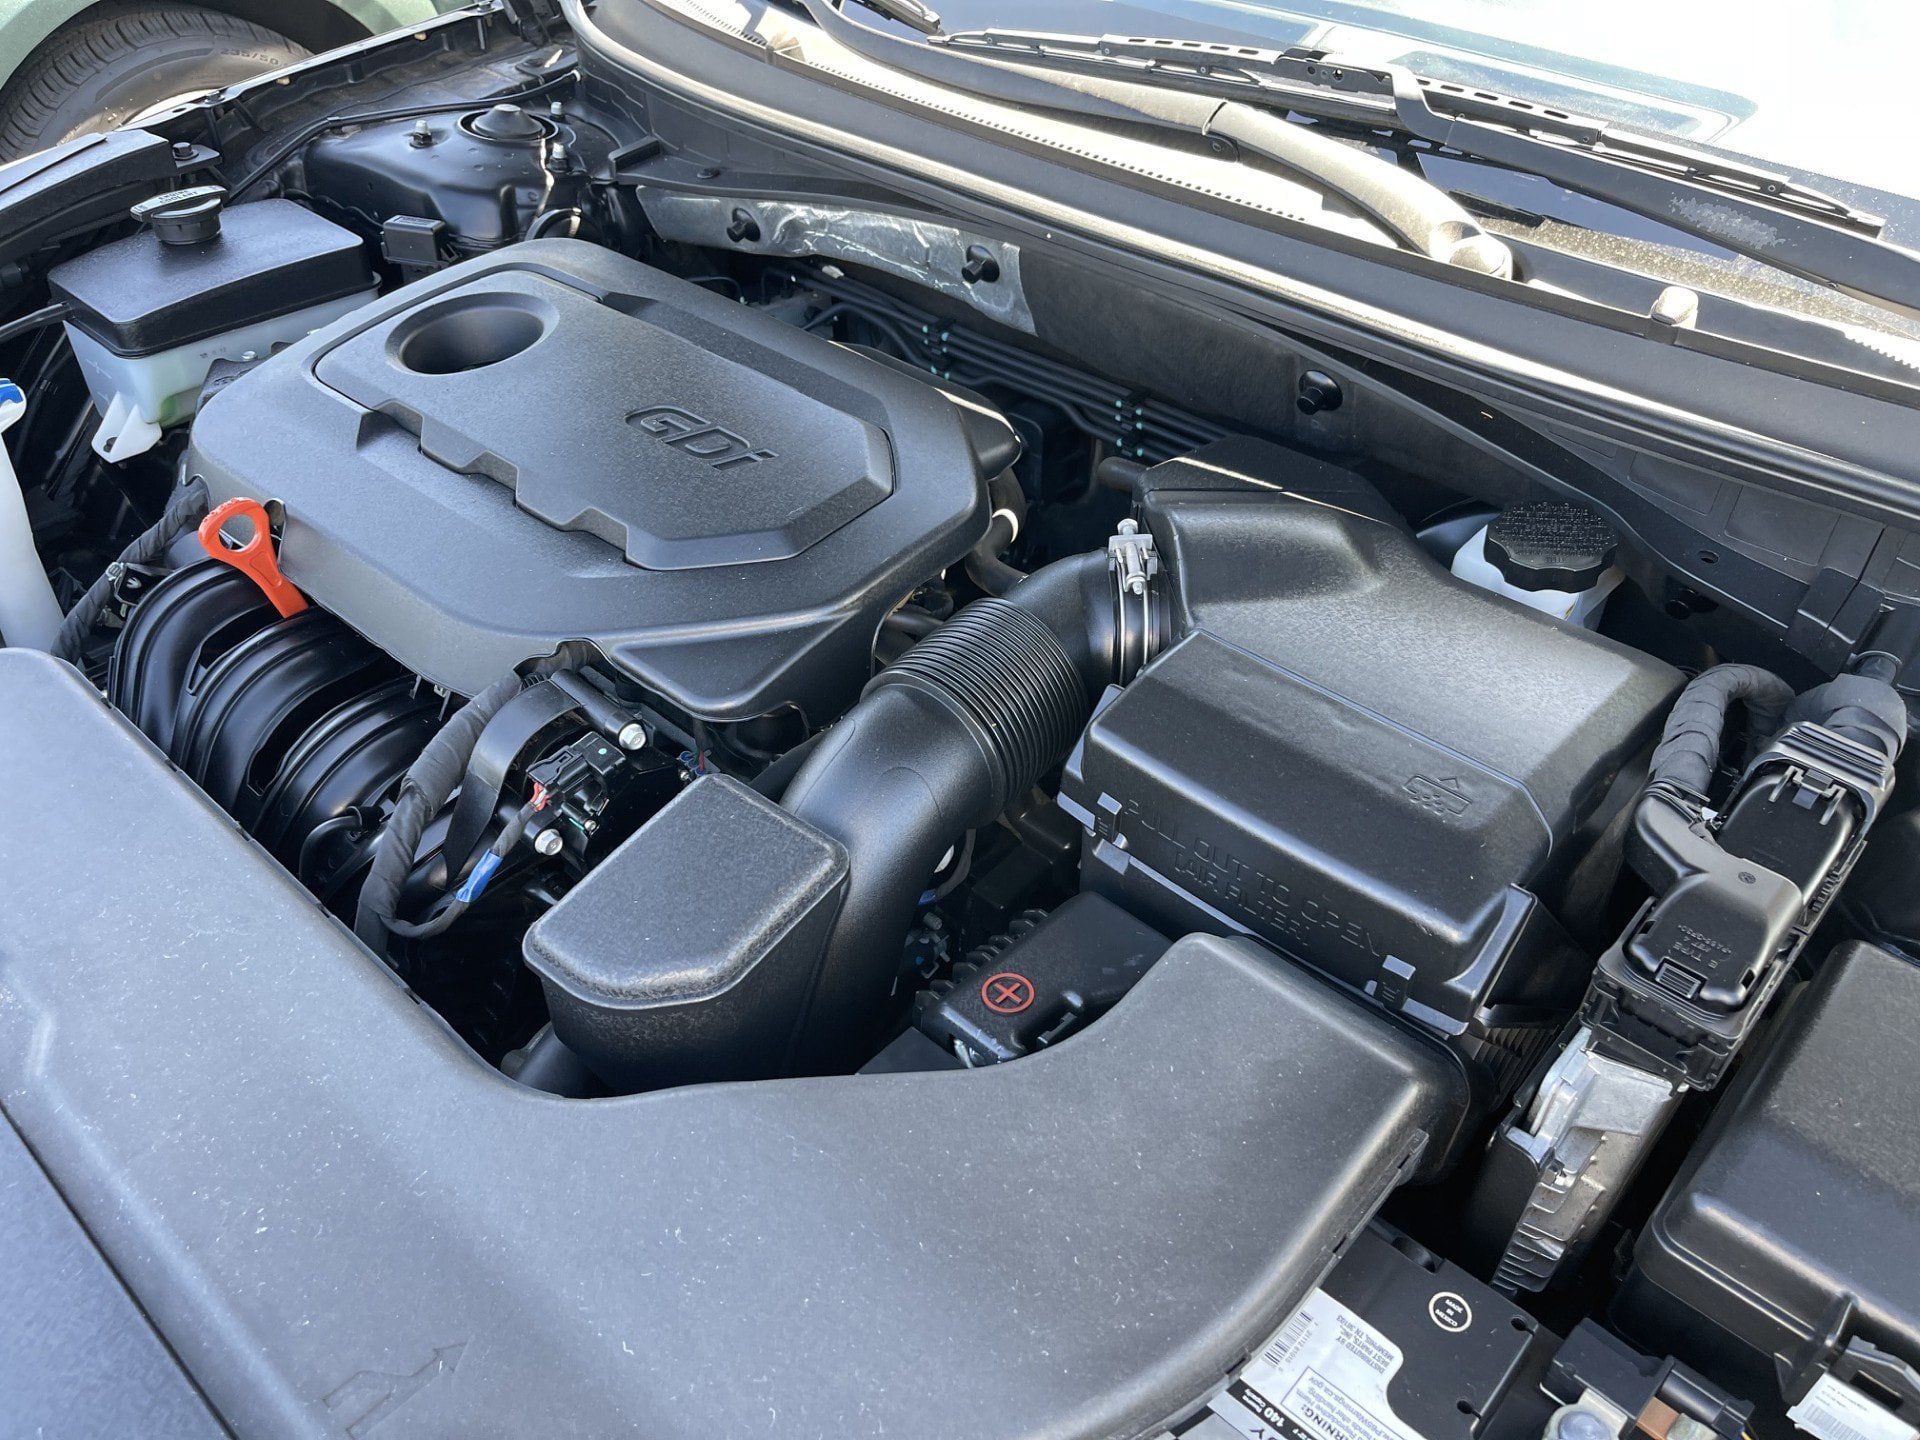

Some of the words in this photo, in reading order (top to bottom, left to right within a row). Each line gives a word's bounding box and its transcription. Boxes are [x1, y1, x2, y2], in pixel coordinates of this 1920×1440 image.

[1124, 799, 1185, 849] PULL
[1194, 838, 1249, 881] OUT
[1257, 872, 1290, 907] TO
[1301, 900, 1380, 957] OPEN
[1336, 1335, 1347, 1346] BY
[1345, 1342, 1385, 1374] DISTRIBUTED
[1372, 1353, 1390, 1368] BEST
[1264, 1407, 1285, 1427] 140
